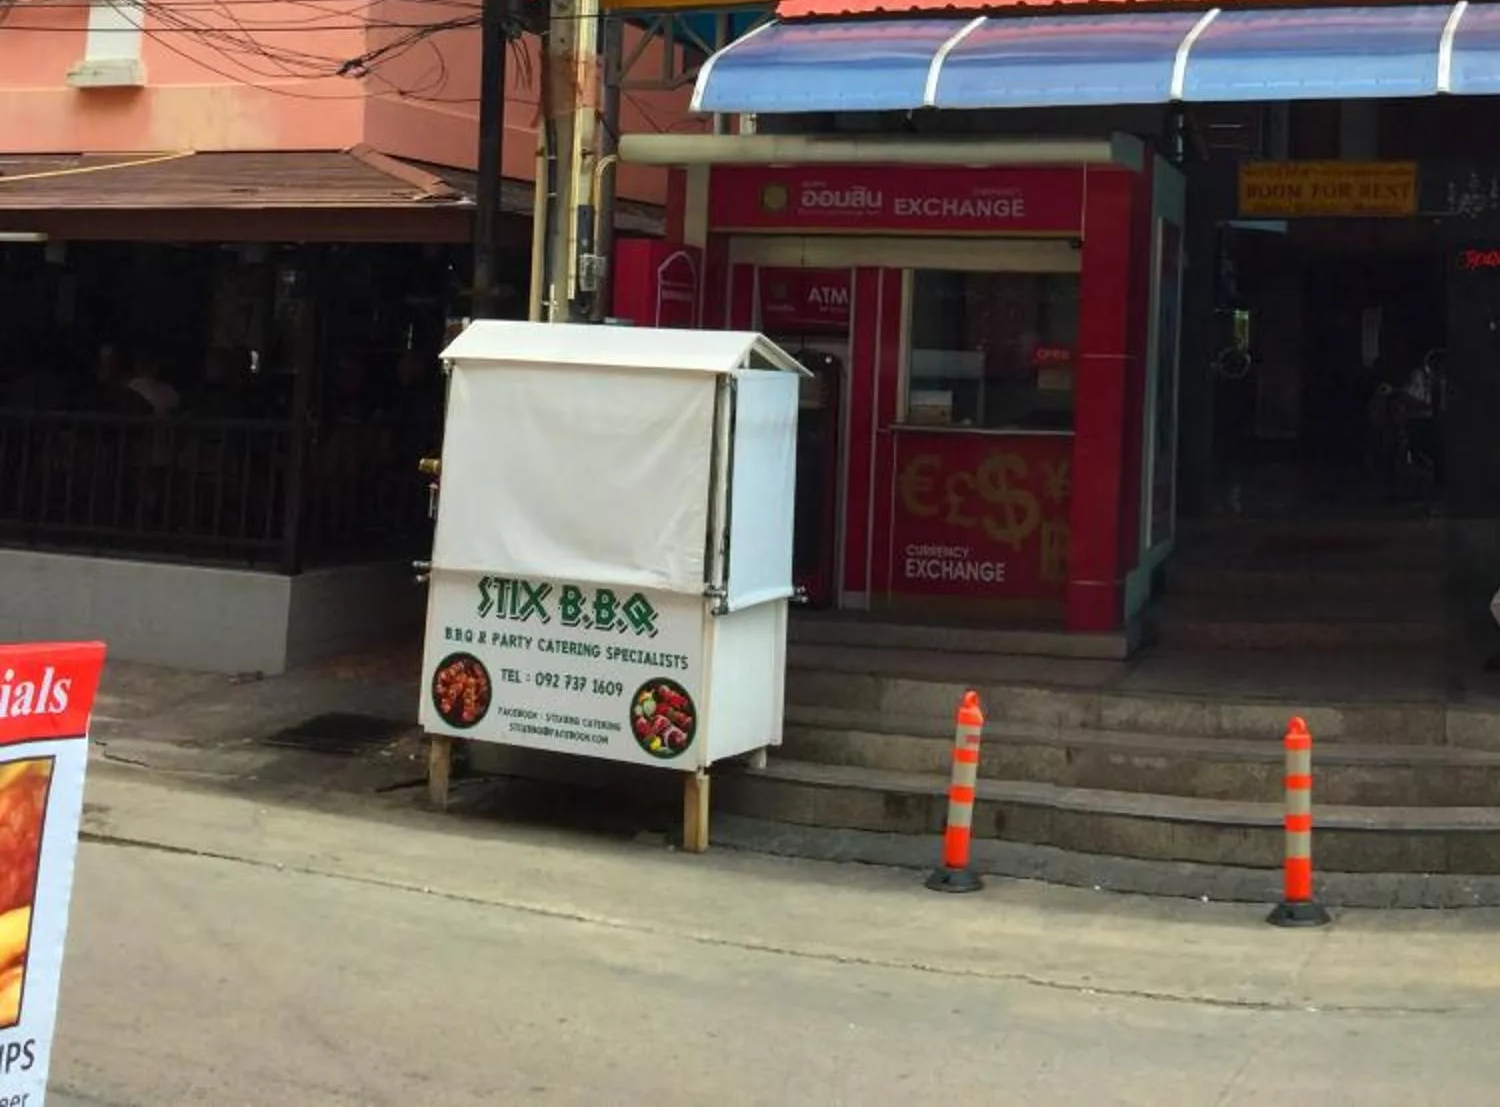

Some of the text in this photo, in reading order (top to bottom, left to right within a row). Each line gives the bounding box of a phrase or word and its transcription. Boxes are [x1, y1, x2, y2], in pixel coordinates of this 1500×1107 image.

[894, 197, 1026, 218] EXCHANGE
[807, 286, 849, 305] ATM
[904, 558, 1007, 583] EXCHANGE
[477, 576, 553, 625] STIX
[492, 633, 533, 650] PARTY
[538, 638, 601, 658] CATERING
[606, 646, 689, 670] SPECIALISTS
[500, 668, 522, 683] TEL
[535, 672, 559, 688] 092
[565, 675, 587, 692] 737
[592, 679, 624, 697] 1609
